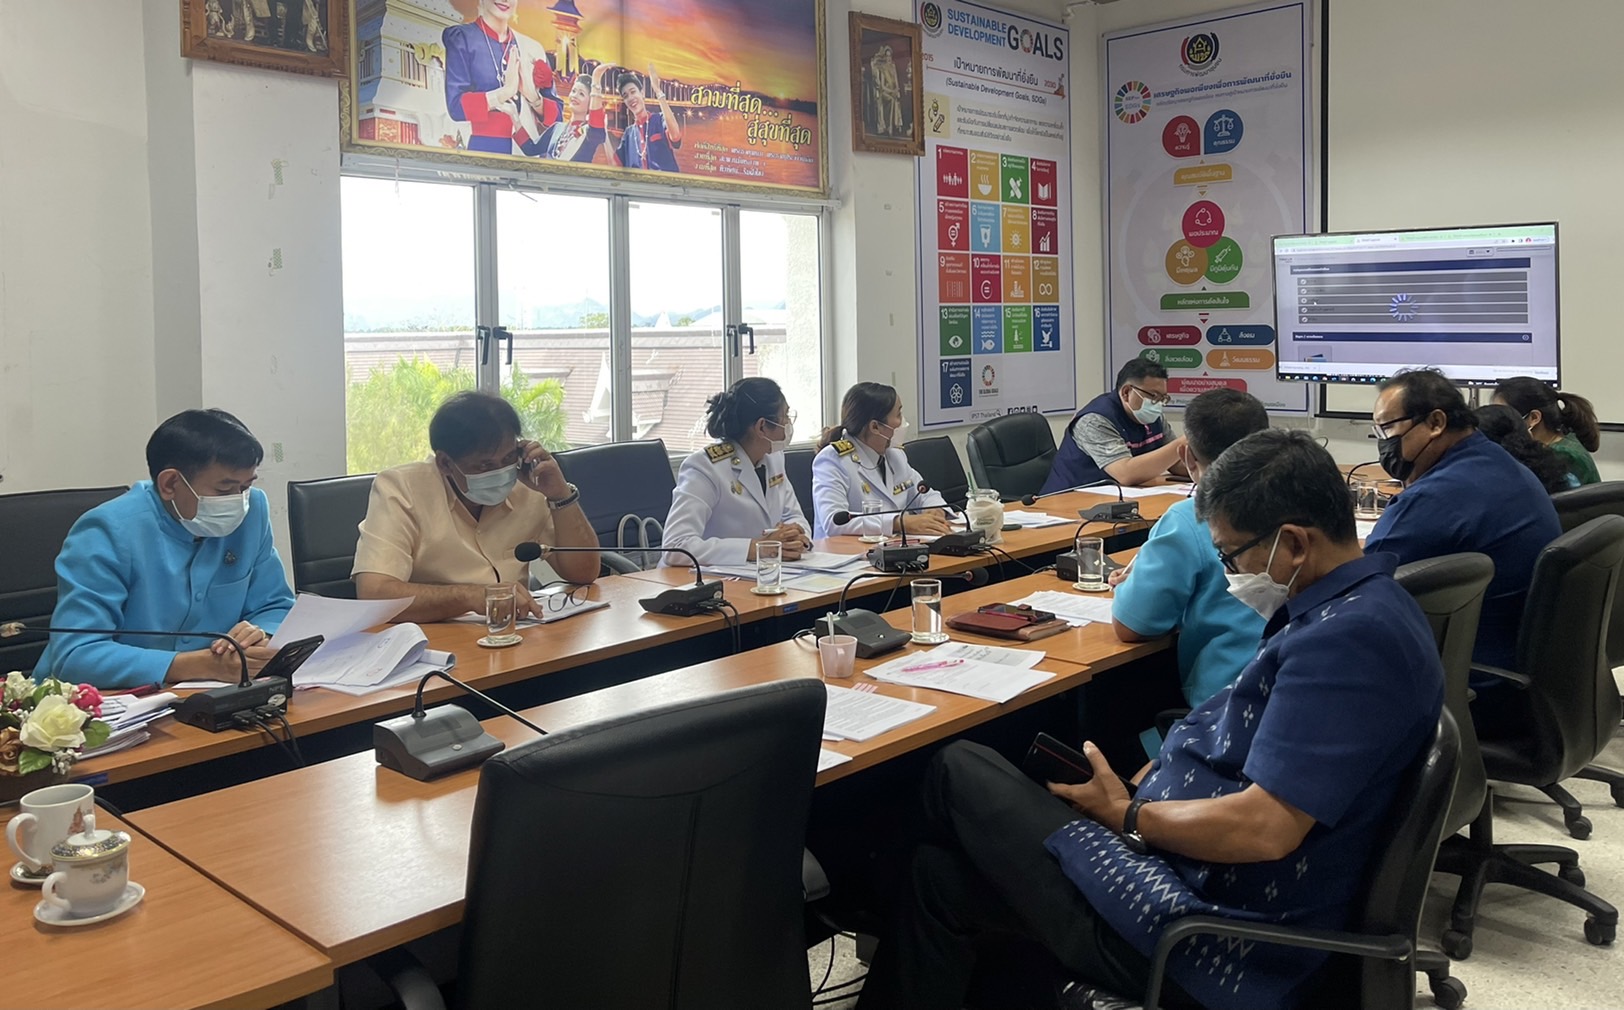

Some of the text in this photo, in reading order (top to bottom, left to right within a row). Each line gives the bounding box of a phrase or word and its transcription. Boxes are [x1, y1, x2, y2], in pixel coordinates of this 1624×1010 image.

[947, 9, 1007, 34] SUSTAINABLE
[948, 23, 1006, 47] DEVELOPMENT
[1007, 25, 1063, 61] GOALS
[953, 56, 1039, 86] เป้าหมายการพัฒนาที่ยั่งยืน
[945, 77, 980, 92] (Sustainable
[981, 84, 1014, 98] Development
[1153, 70, 1292, 99] เศรษฐกิจพอเพียงเพื่อการพัฒนาที่ยั่งยืน
[690, 80, 778, 119] สามที่สุด...
[747, 113, 811, 151] สู่สุขที่สุด
[971, 152, 976, 163] 2
[1002, 156, 1007, 167] 3
[1031, 161, 1036, 171] 4
[939, 201, 944, 213] 5
[972, 205, 977, 215] 6
[1032, 210, 1037, 220] 8
[940, 256, 945, 267] 9
